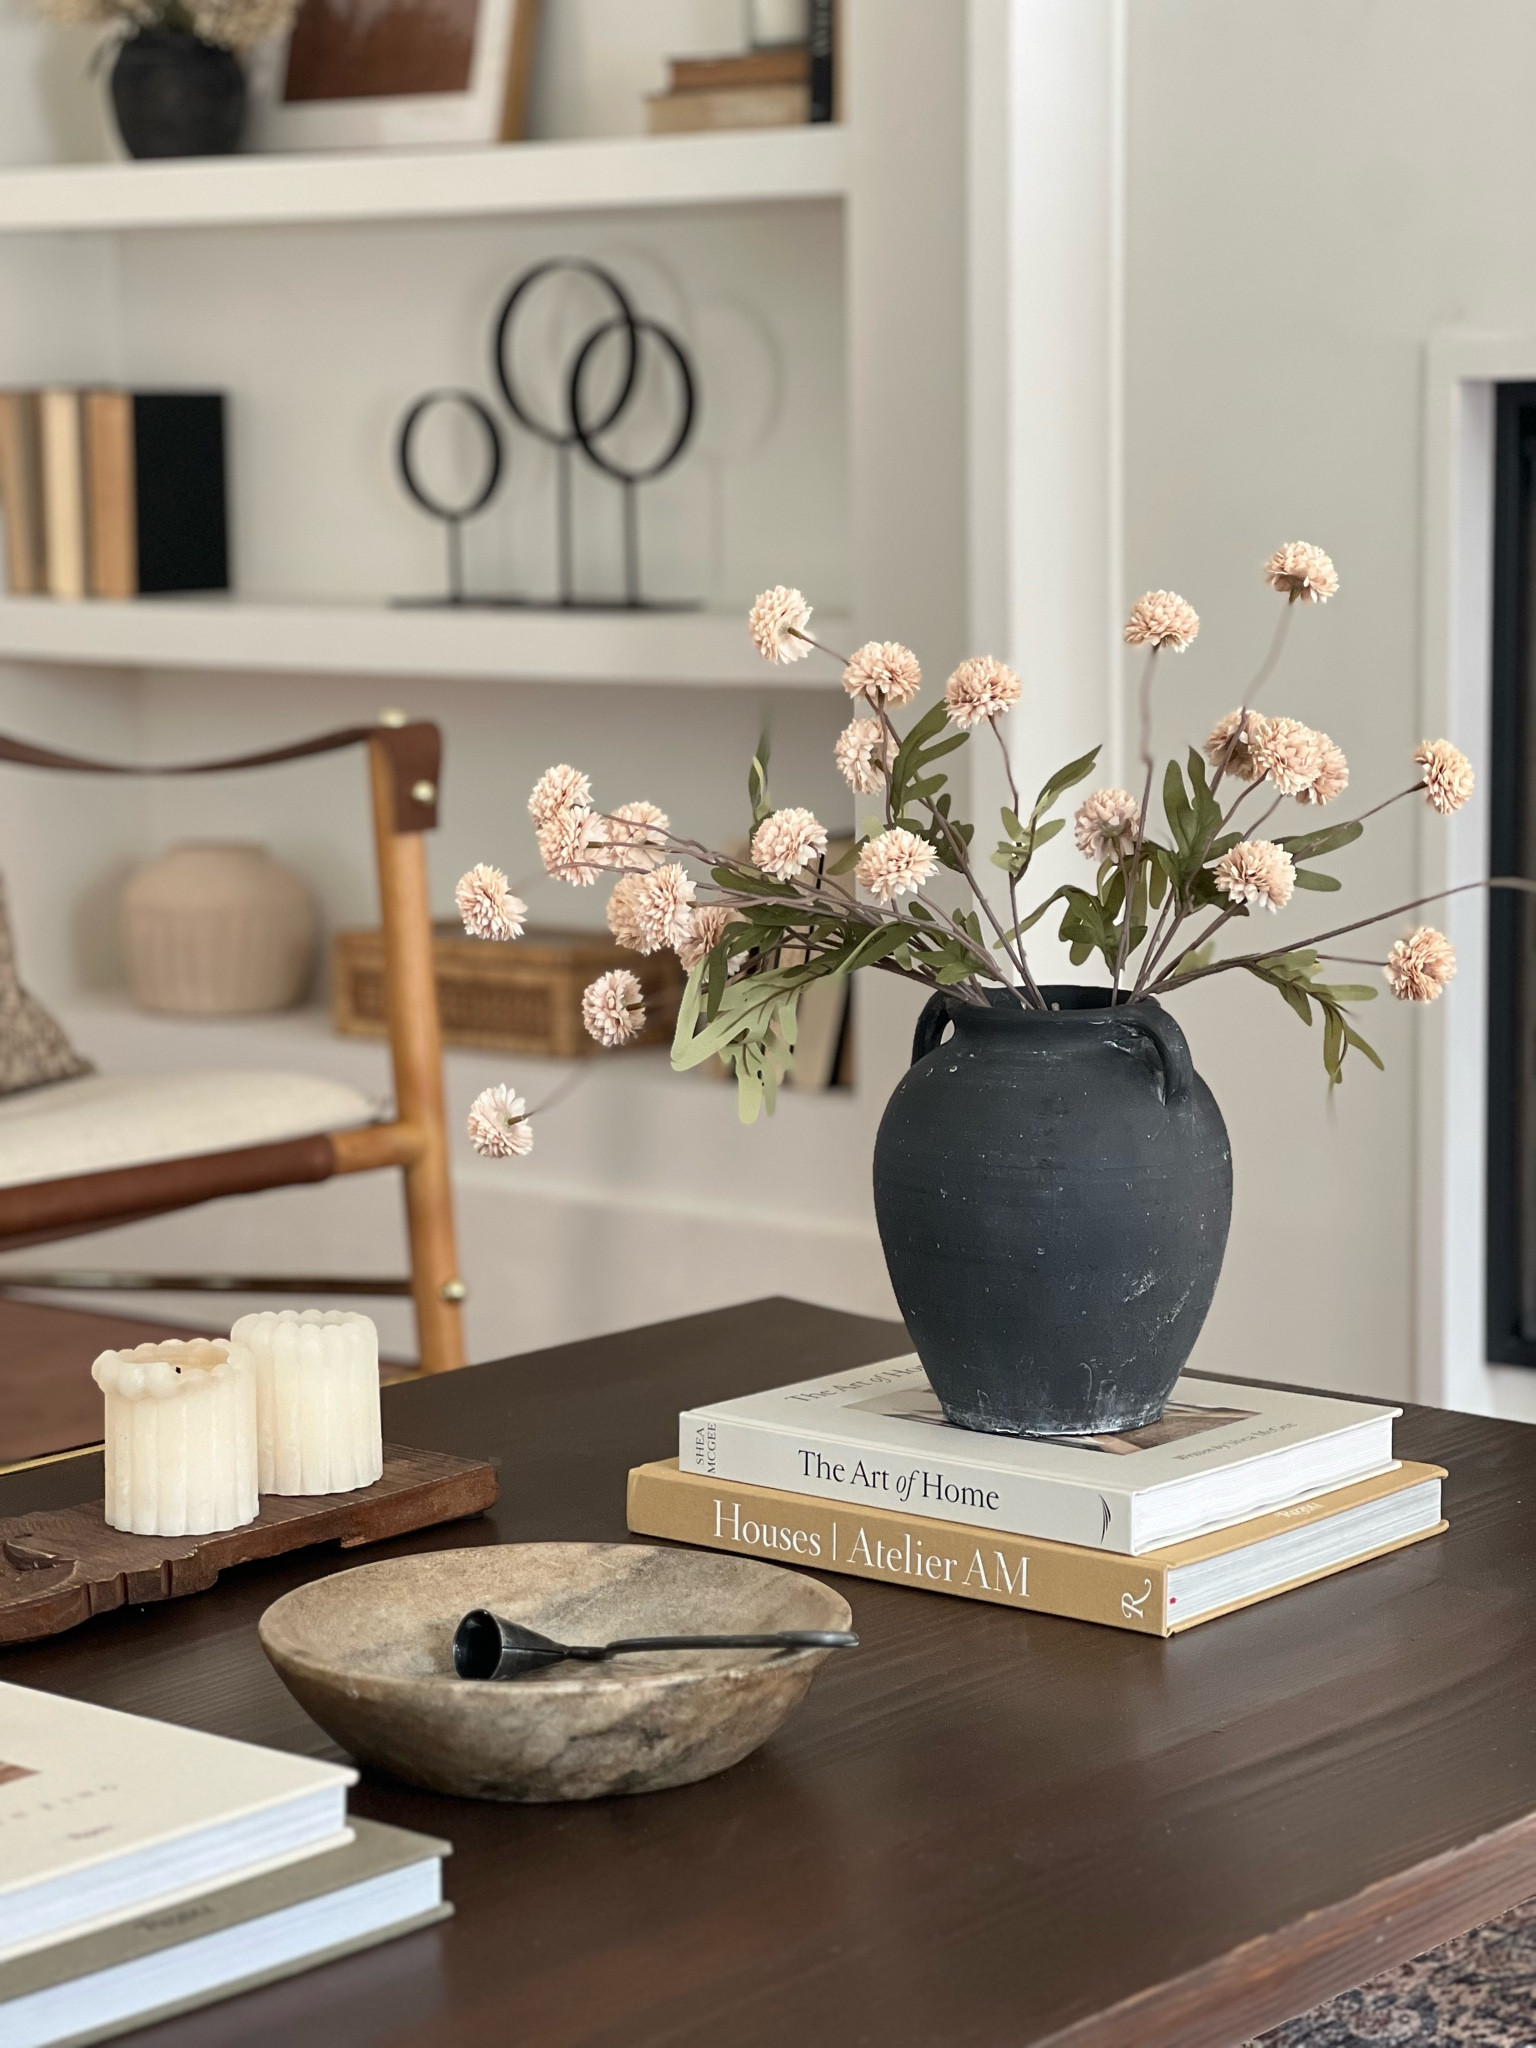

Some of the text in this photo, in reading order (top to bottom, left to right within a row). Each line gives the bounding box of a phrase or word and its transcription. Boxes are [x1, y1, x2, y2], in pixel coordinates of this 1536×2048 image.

[784, 1389, 837, 1402] The
[833, 1380, 873, 1393] Art
[882, 1364, 924, 1378] Ho
[695, 1427, 705, 1466] SHEA
[706, 1422, 717, 1474] MCGEE
[797, 1449, 1000, 1511] The Art of Home
[712, 1499, 822, 1557] Houses
[846, 1526, 958, 1582] Atelier
[961, 1548, 1031, 1598] AM
